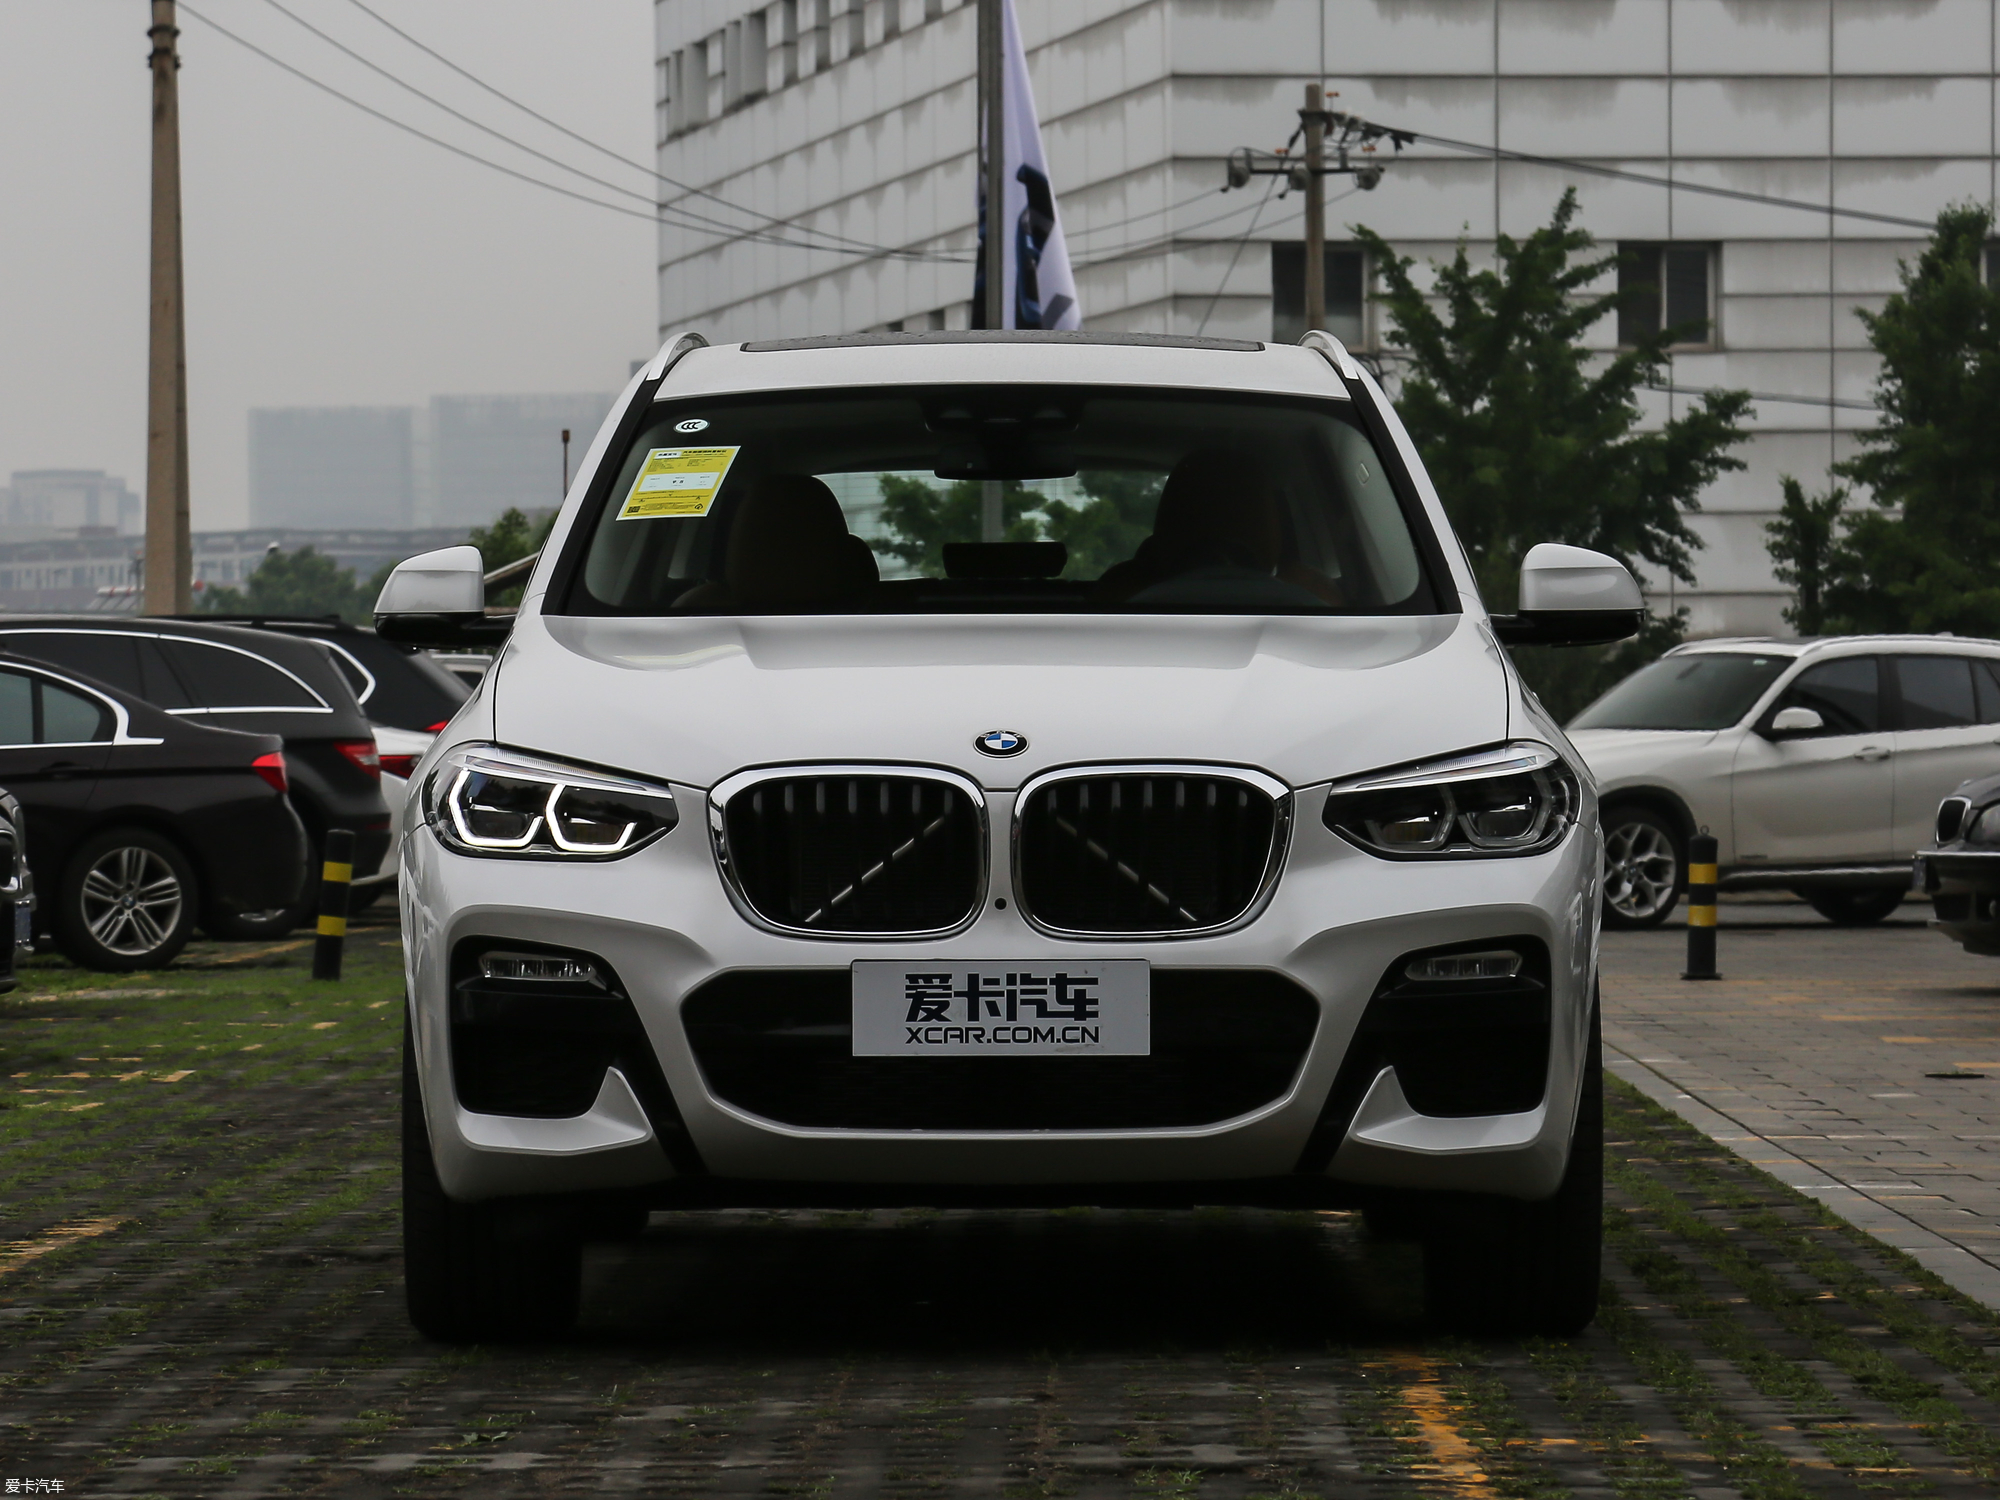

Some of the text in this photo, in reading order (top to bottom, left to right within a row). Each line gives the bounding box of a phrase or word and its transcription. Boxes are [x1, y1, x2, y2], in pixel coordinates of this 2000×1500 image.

[905, 973, 1099, 1022] 爱卡汽车
[905, 1026, 1099, 1044] XCAR.COM.CN
